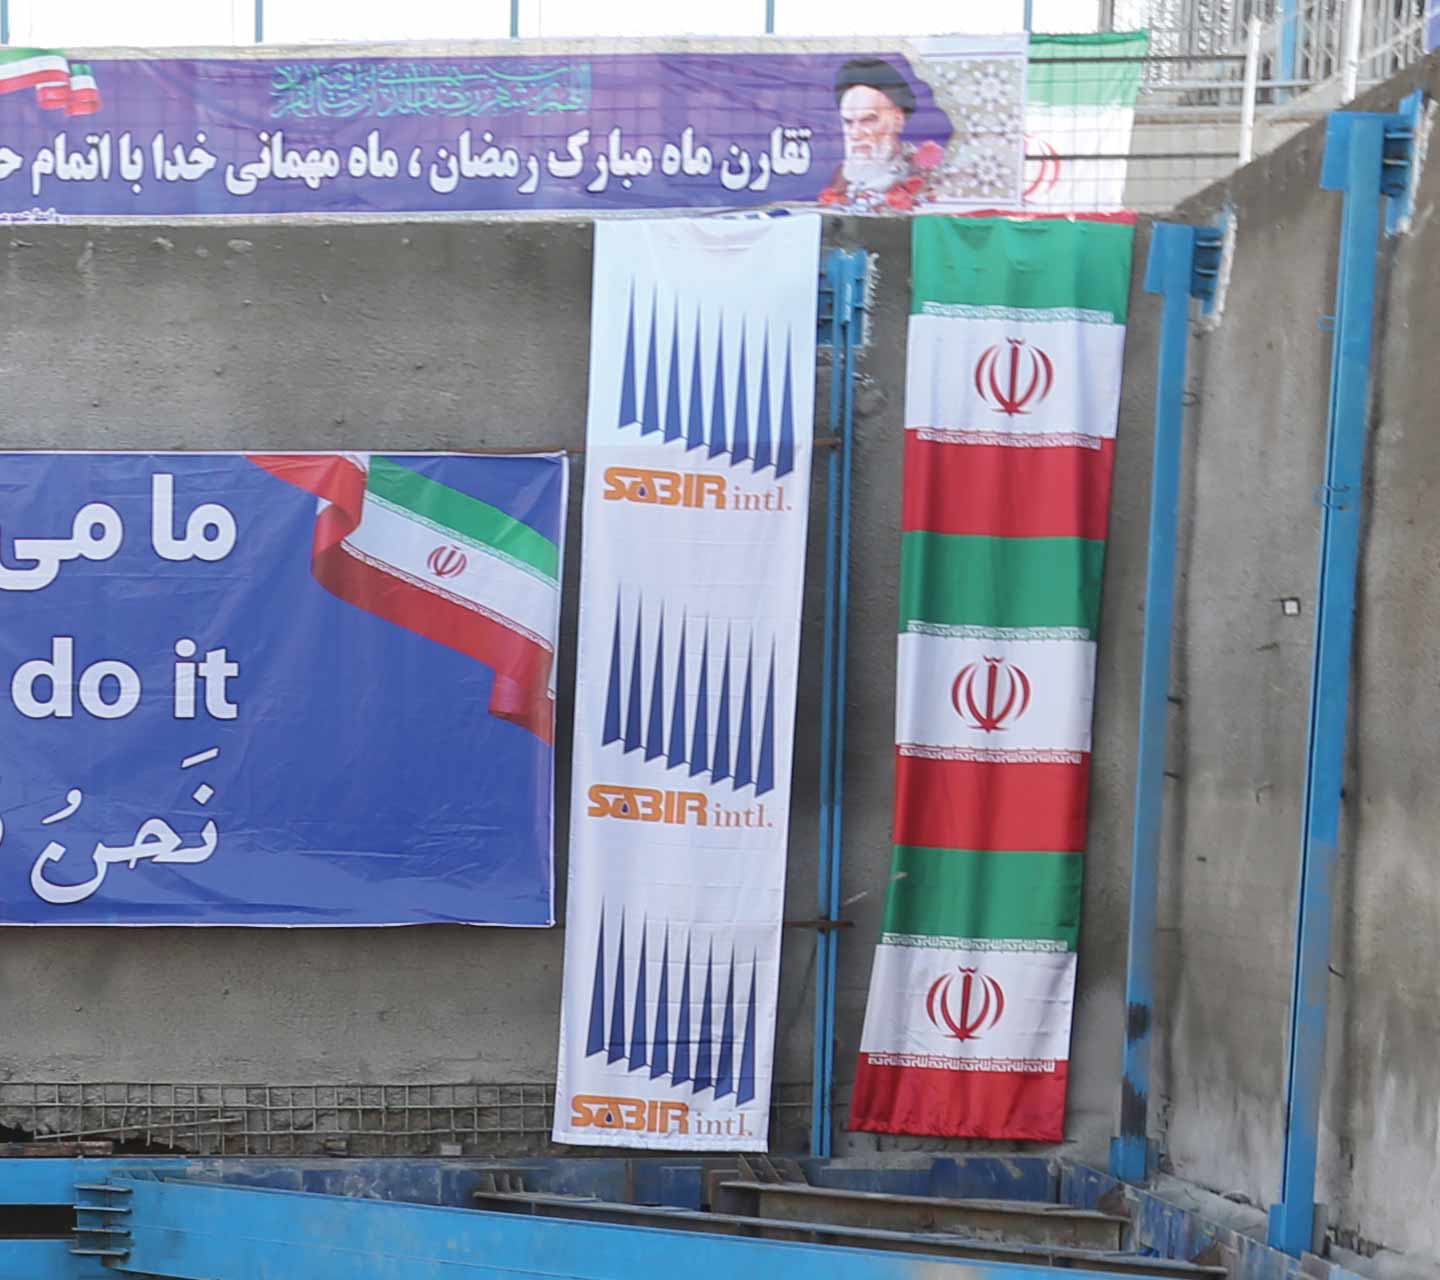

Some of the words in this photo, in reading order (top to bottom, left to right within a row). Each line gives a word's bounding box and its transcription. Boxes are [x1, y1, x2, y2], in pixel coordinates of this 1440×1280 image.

[32, 133, 110, 195] اتمام
[119, 133, 143, 193] با
[152, 133, 216, 181] خدا
[226, 131, 339, 194] مهمانی
[348, 131, 398, 177] ماه
[430, 130, 538, 193] رمضان
[548, 128, 653, 191] مبارک
[662, 128, 712, 175] ماه
[721, 127, 811, 190] تقارن
[153, 474, 236, 561] ما
[602, 466, 727, 510] SABIR
[12, 637, 140, 718] do
[175, 639, 238, 719] it
[586, 783, 708, 827] SABIR
[571, 1094, 689, 1134] SABIR
